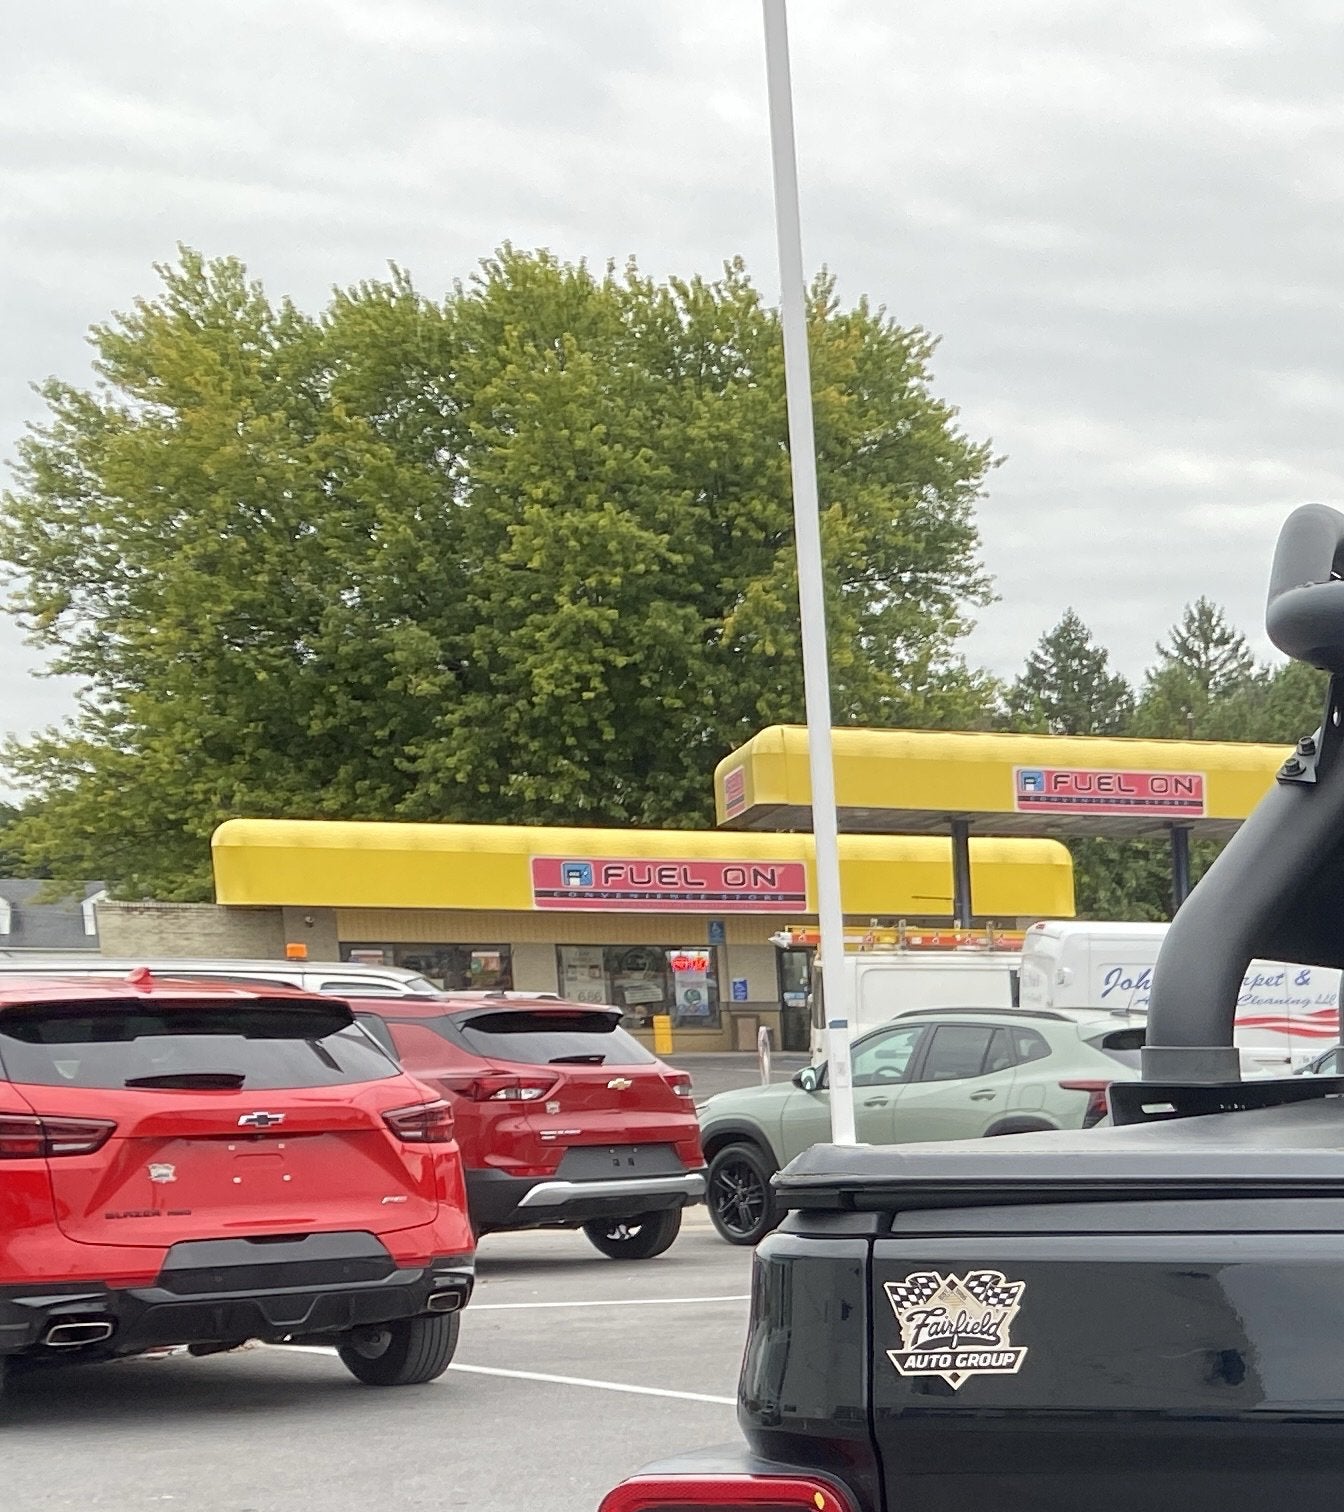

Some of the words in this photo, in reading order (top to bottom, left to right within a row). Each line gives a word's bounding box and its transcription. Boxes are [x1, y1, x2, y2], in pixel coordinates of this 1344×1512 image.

[1053, 774, 1135, 793] FUEL
[1150, 776, 1193, 795] ON
[602, 864, 706, 887] FUEL
[722, 866, 780, 888] ON
[553, 891, 706, 901] CONVENIENCE
[720, 893, 784, 901] STORE
[1101, 967, 1152, 998] Joh
[1294, 969, 1311, 986] &
[1237, 993, 1310, 1008] Cleaning
[906, 1307, 1008, 1350] Fairfield
[904, 1354, 951, 1369] AUTO
[955, 1352, 1016, 1368] GROUP
